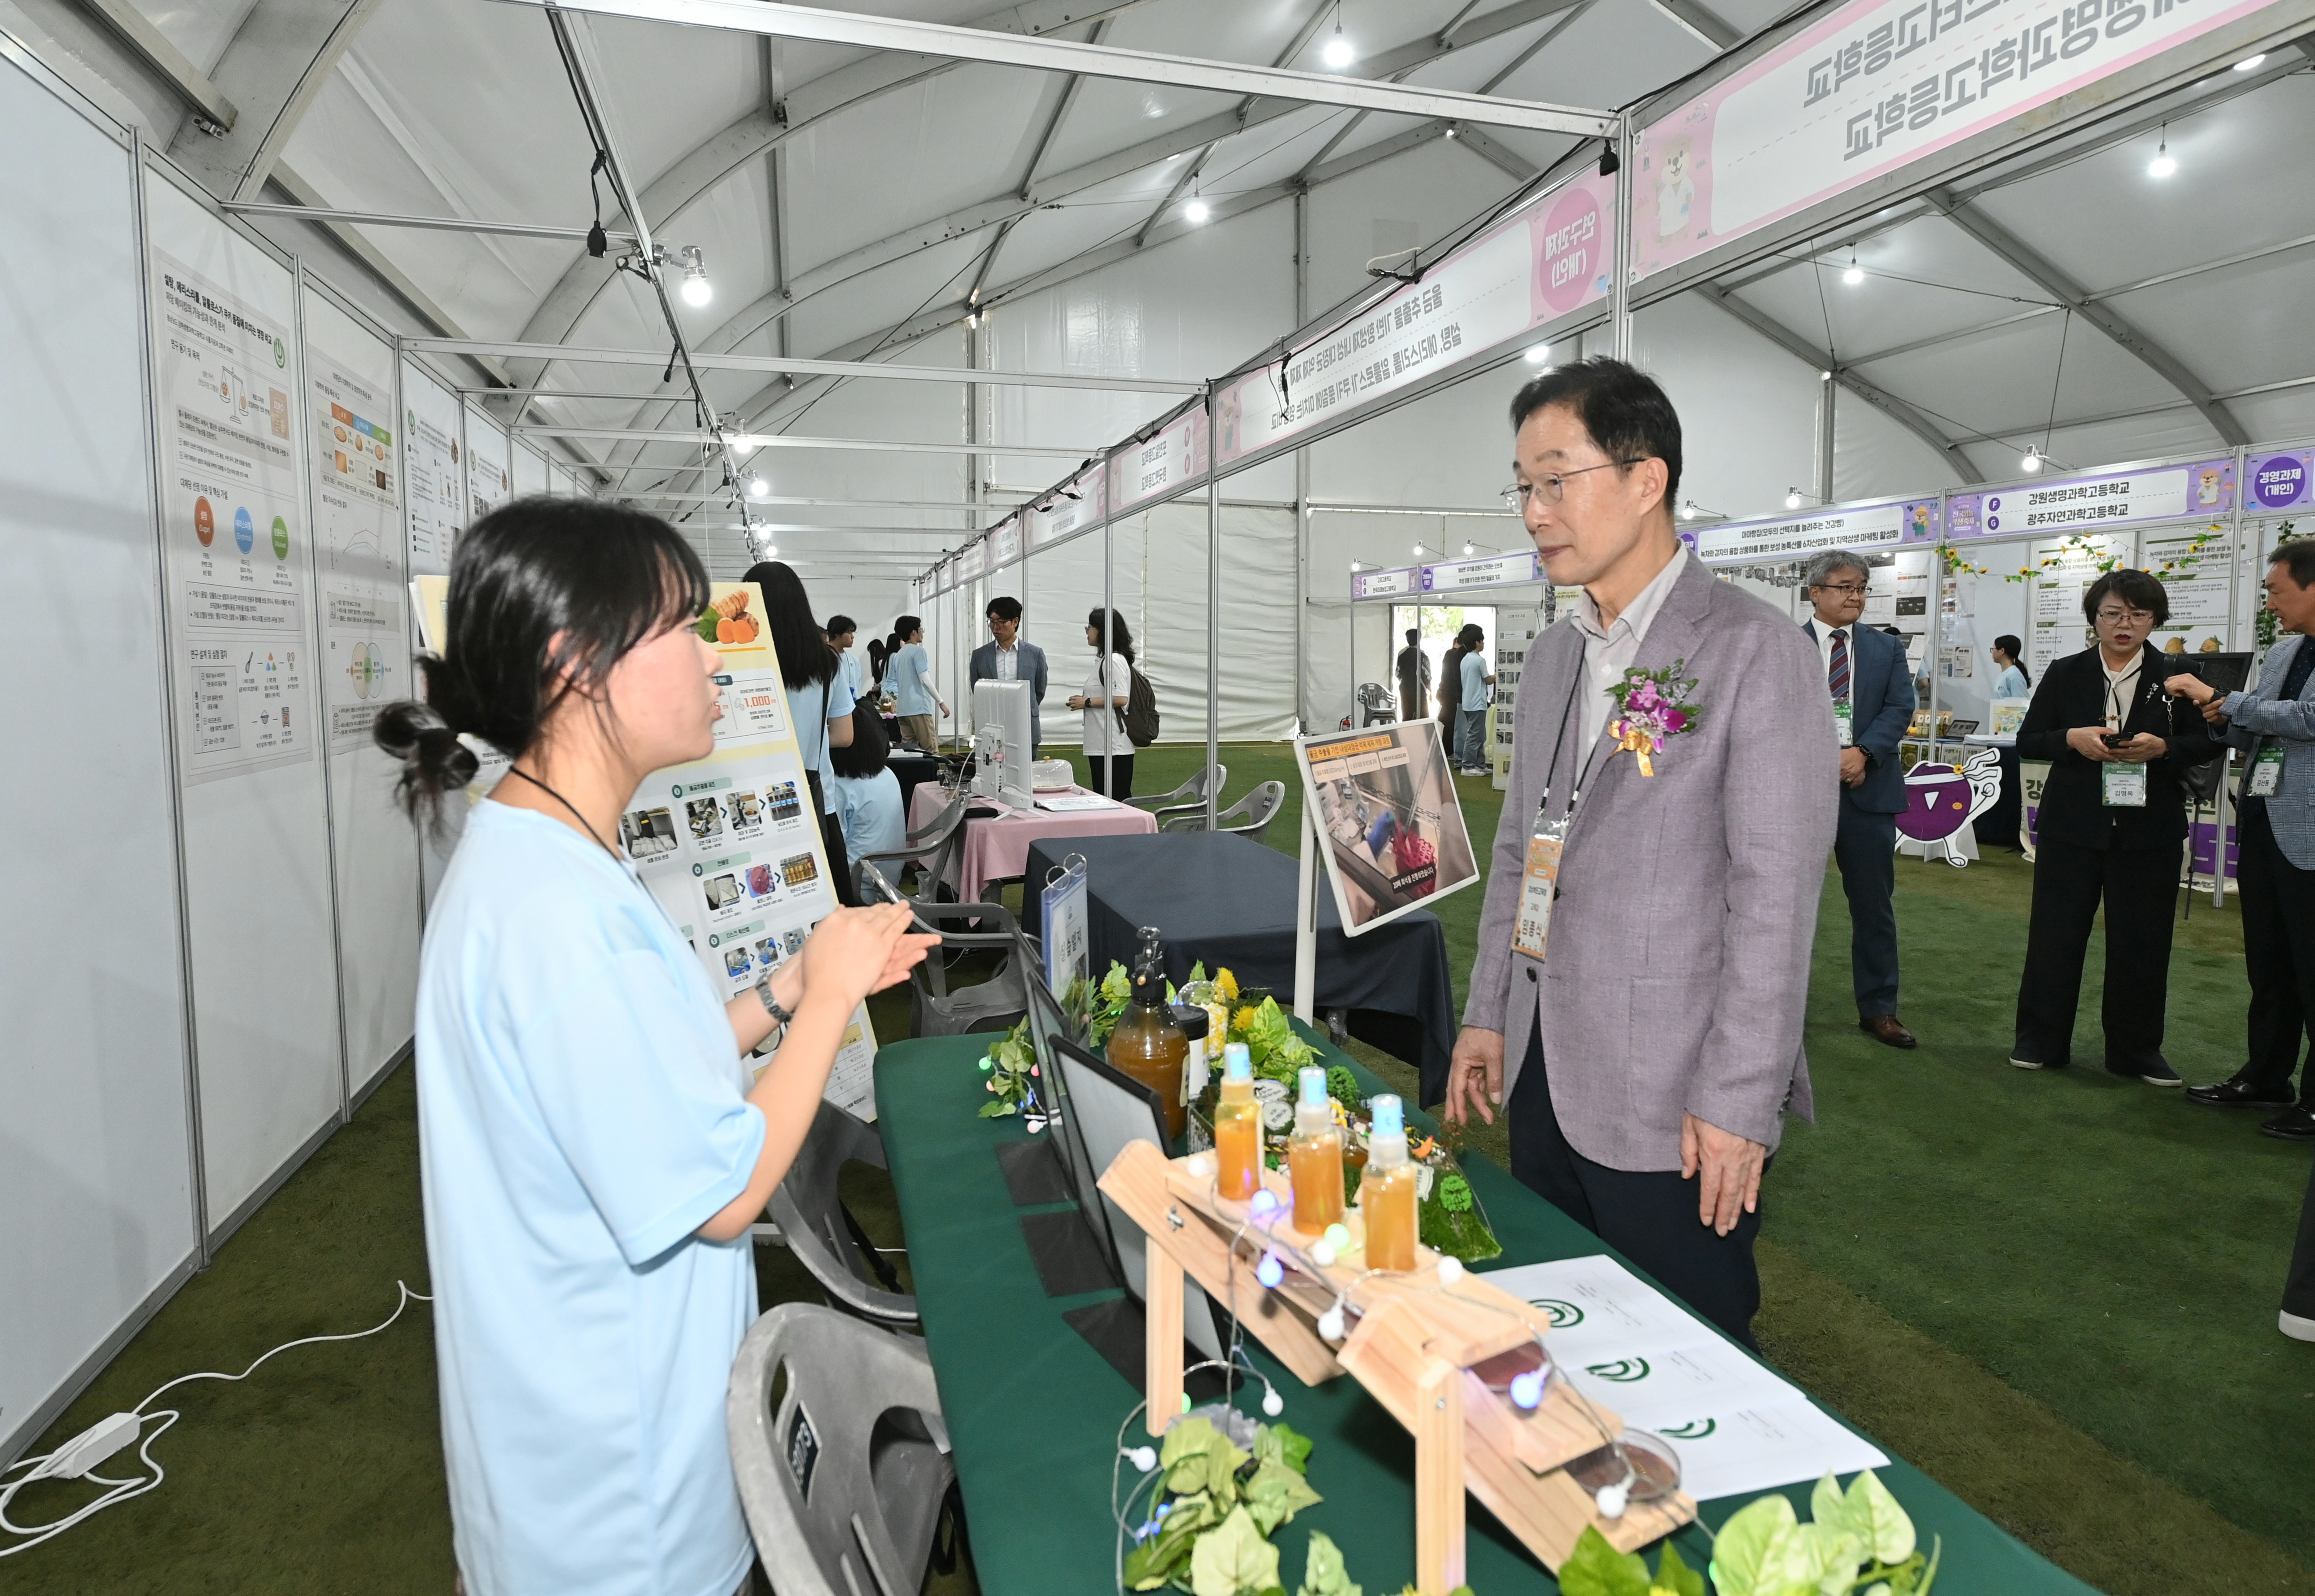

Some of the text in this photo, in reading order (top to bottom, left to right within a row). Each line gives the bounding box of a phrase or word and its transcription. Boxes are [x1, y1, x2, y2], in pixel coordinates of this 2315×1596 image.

[165, 273, 176, 292] 설탕,
[2259, 468, 2302, 483] 경영과제
[2028, 482, 2130, 506] 강원생명과학고등학교
[2265, 482, 2294, 497] (개인)
[2026, 503, 2128, 525] 광주자연과학고등학교
[1779, 524, 1800, 534] 선택지를
[1802, 522, 1823, 532] 늘려주는
[1825, 519, 1844, 529] 건강빵)
[1701, 529, 1899, 558] 녹차와 감자의 융합 상품화를 통한 보성 농특산물 6차산업화 및 지역상생 마케팅 활성화
[744, 695, 771, 709] 1,000
